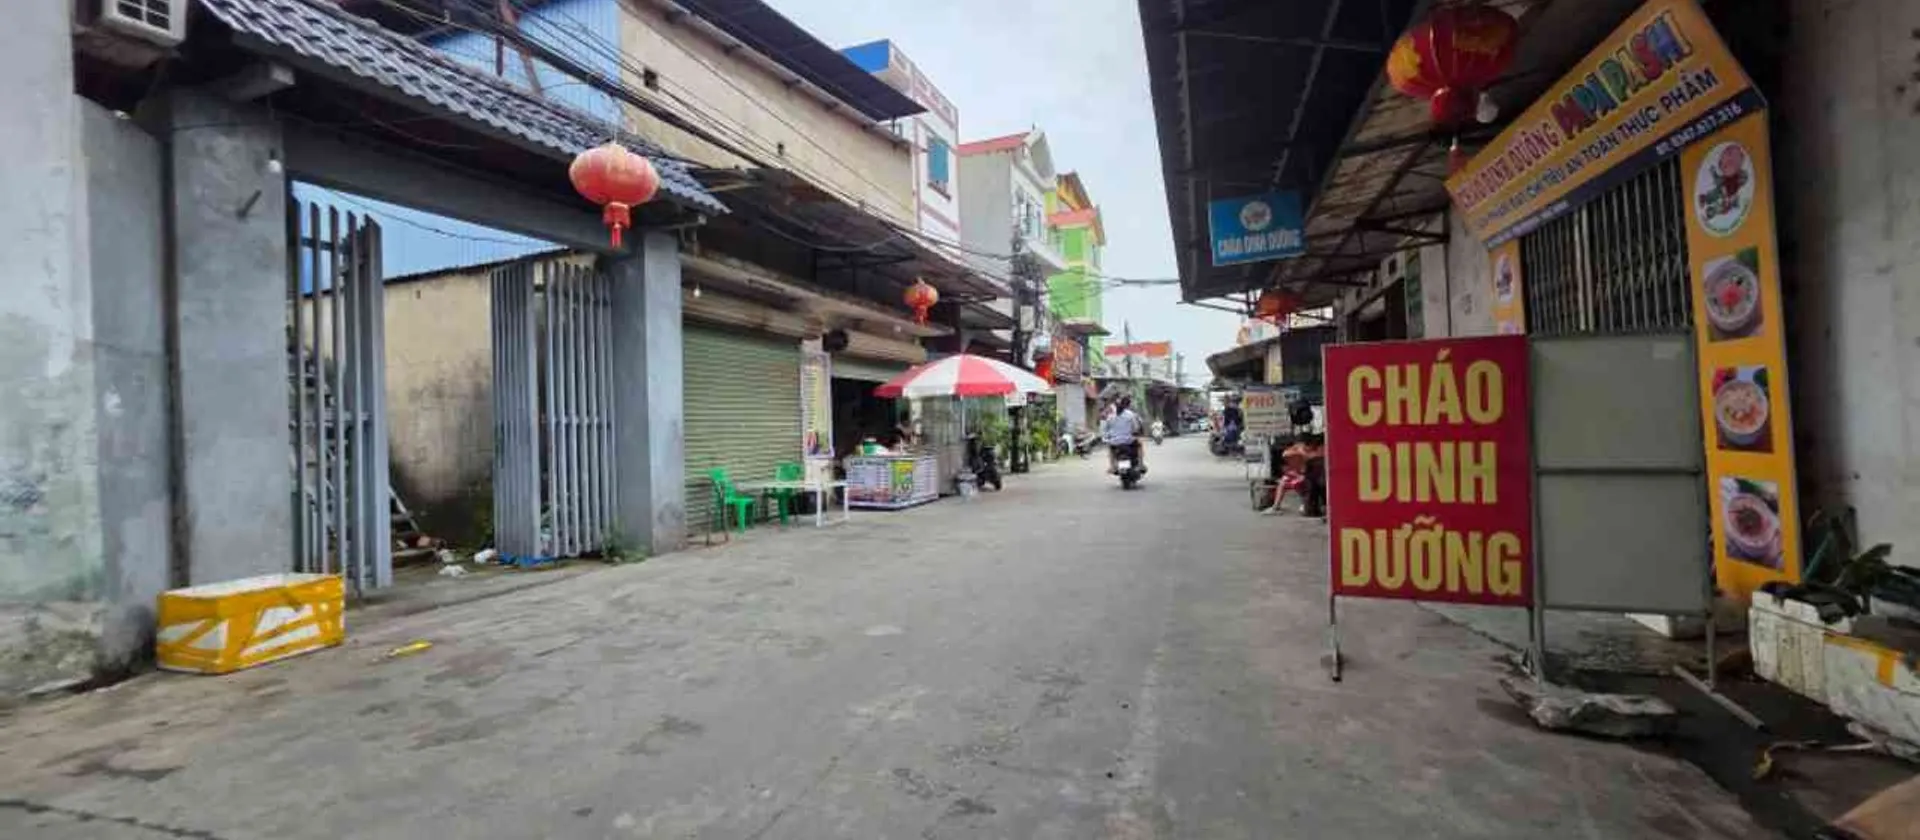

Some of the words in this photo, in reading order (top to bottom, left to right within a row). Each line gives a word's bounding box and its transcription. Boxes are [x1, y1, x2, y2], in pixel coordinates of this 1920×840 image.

[1659, 64, 1719, 114] PHẨM
[1347, 348, 1504, 427] CHÁO
[1357, 441, 1498, 504] DINH
[1340, 515, 1522, 595] DƯỠNG
